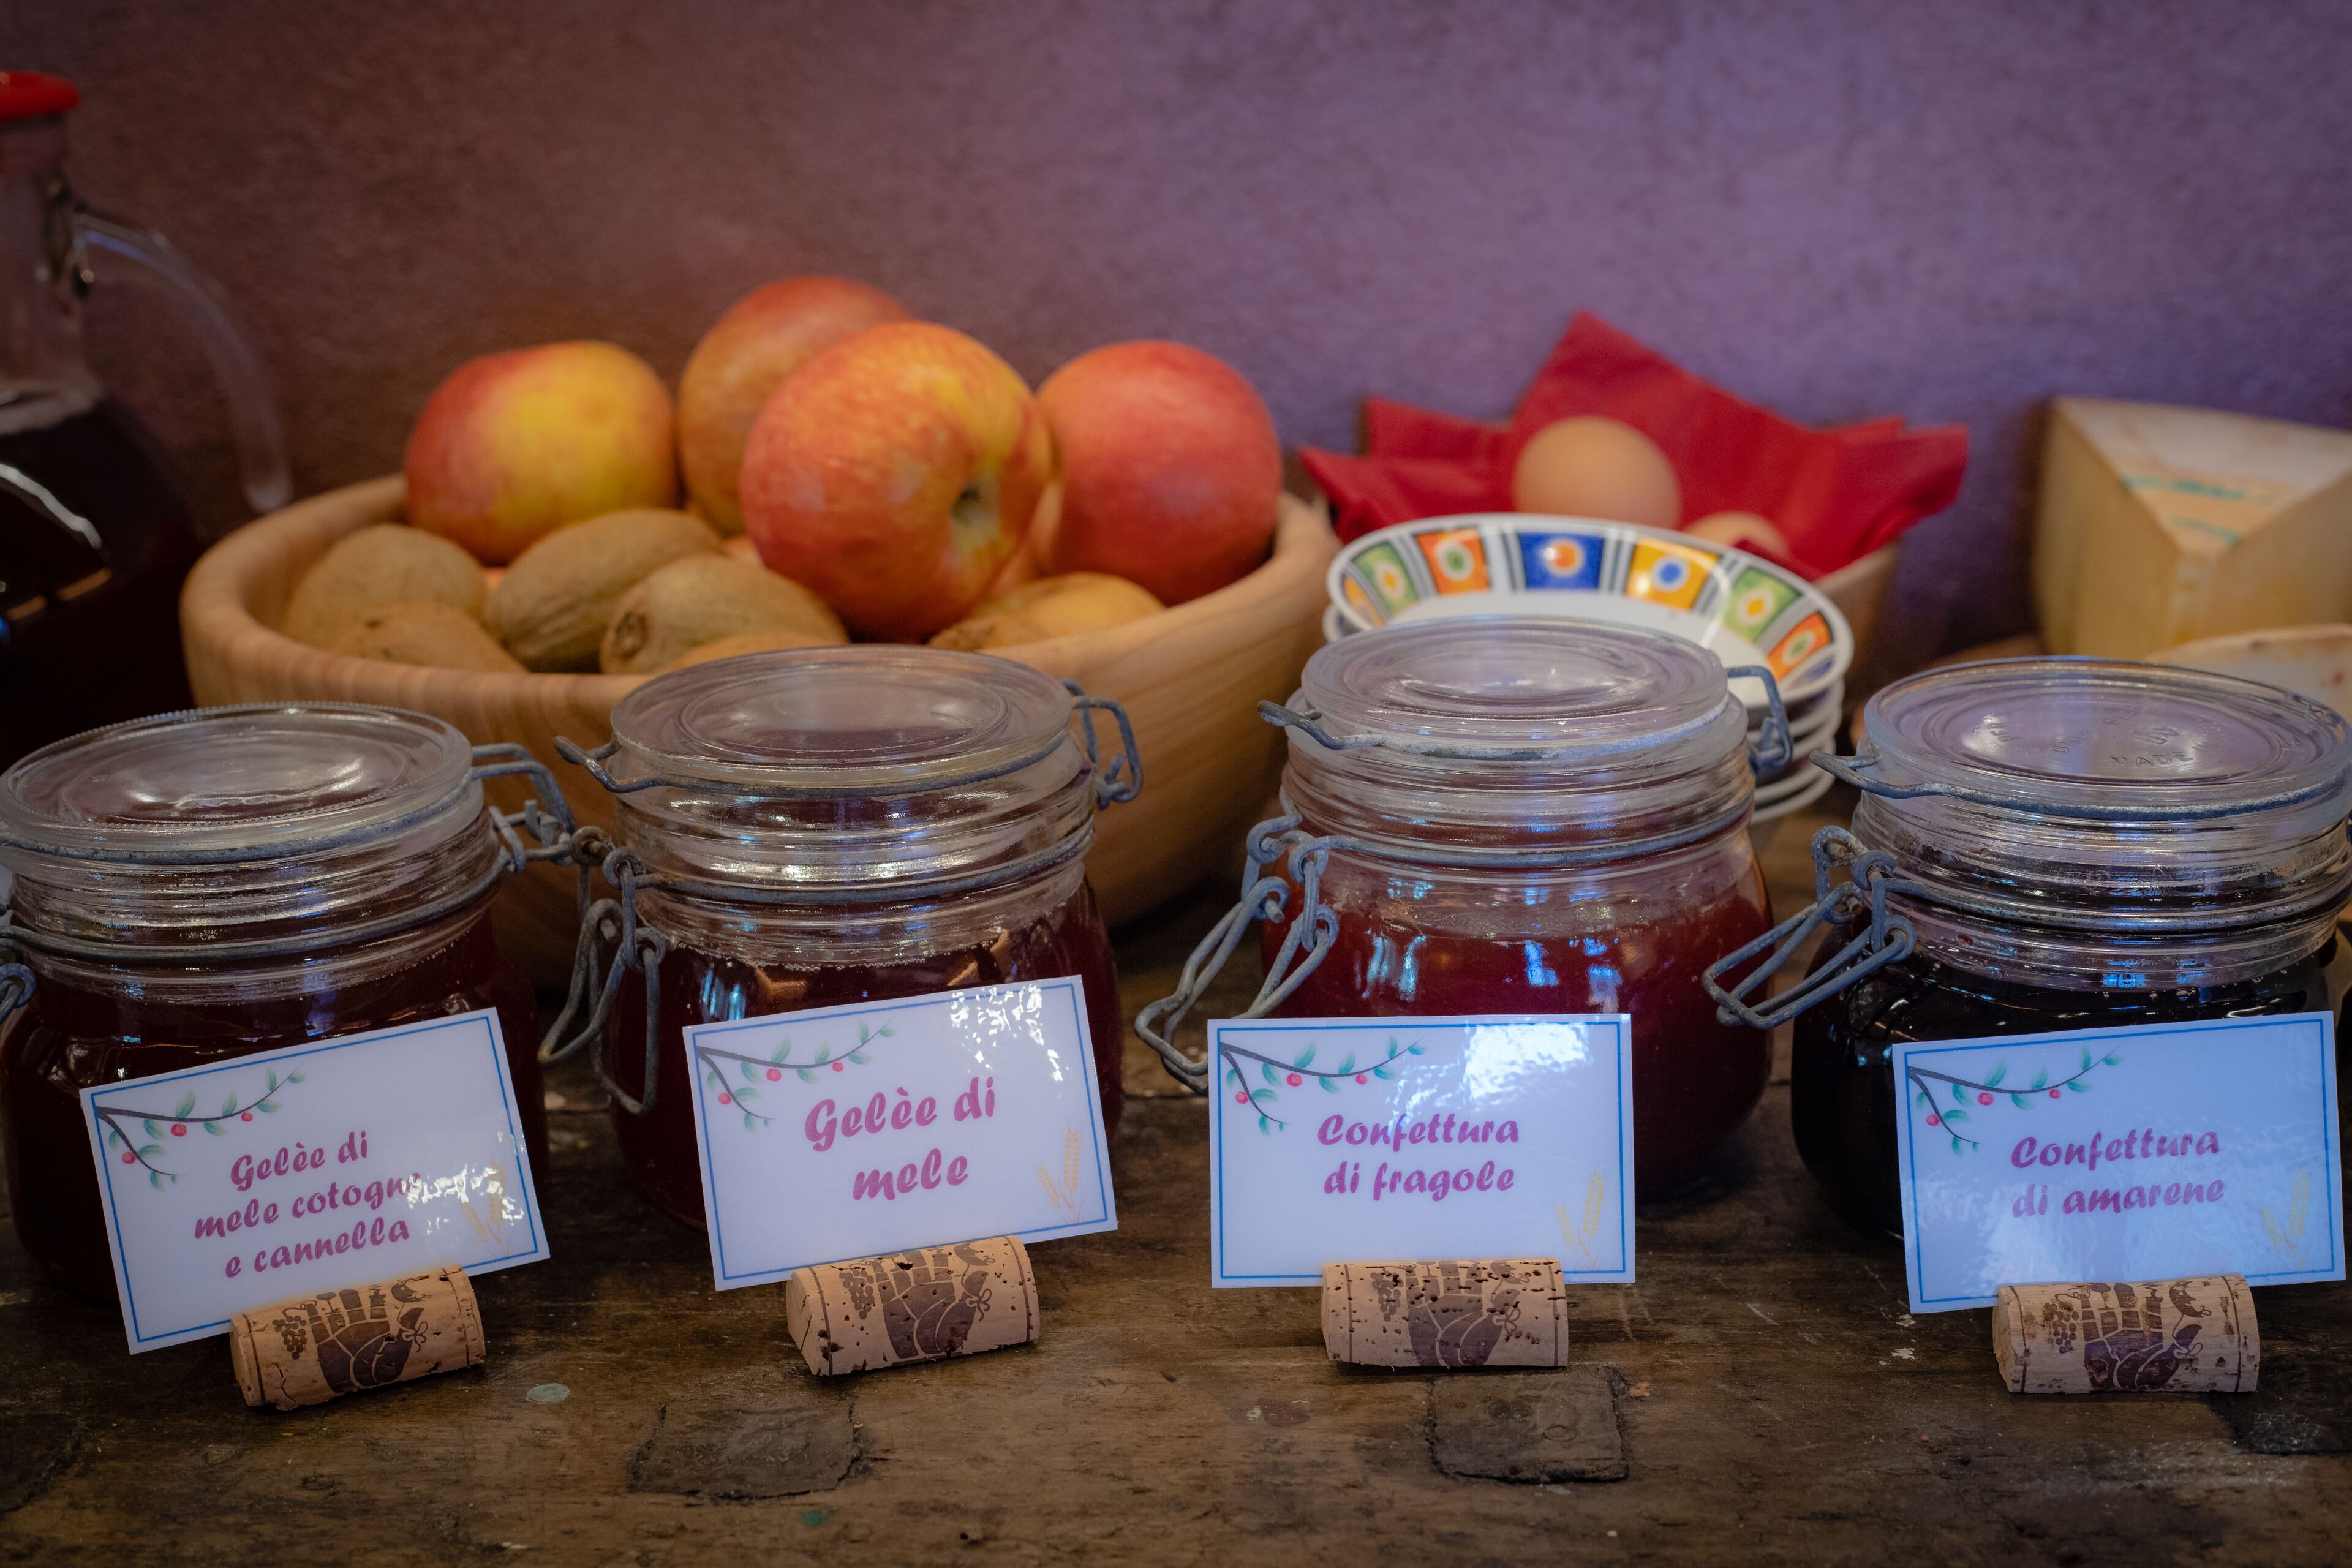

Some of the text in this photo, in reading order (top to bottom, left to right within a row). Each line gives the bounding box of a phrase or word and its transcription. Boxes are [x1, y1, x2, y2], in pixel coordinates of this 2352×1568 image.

[2110, 751, 2194, 766] MADE
[805, 1077, 995, 1152] Gelèe di
[1317, 1112, 1519, 1152] Confettura
[231, 1130, 368, 1192] Gelèe di
[2011, 1128, 2219, 1171] Confettura
[853, 1148, 968, 1200] mele
[1324, 1160, 1514, 1201] di fragole
[195, 1199, 279, 1238] mele
[2013, 1180, 2224, 1218] di amarene
[225, 1216, 410, 1278] e cannella
